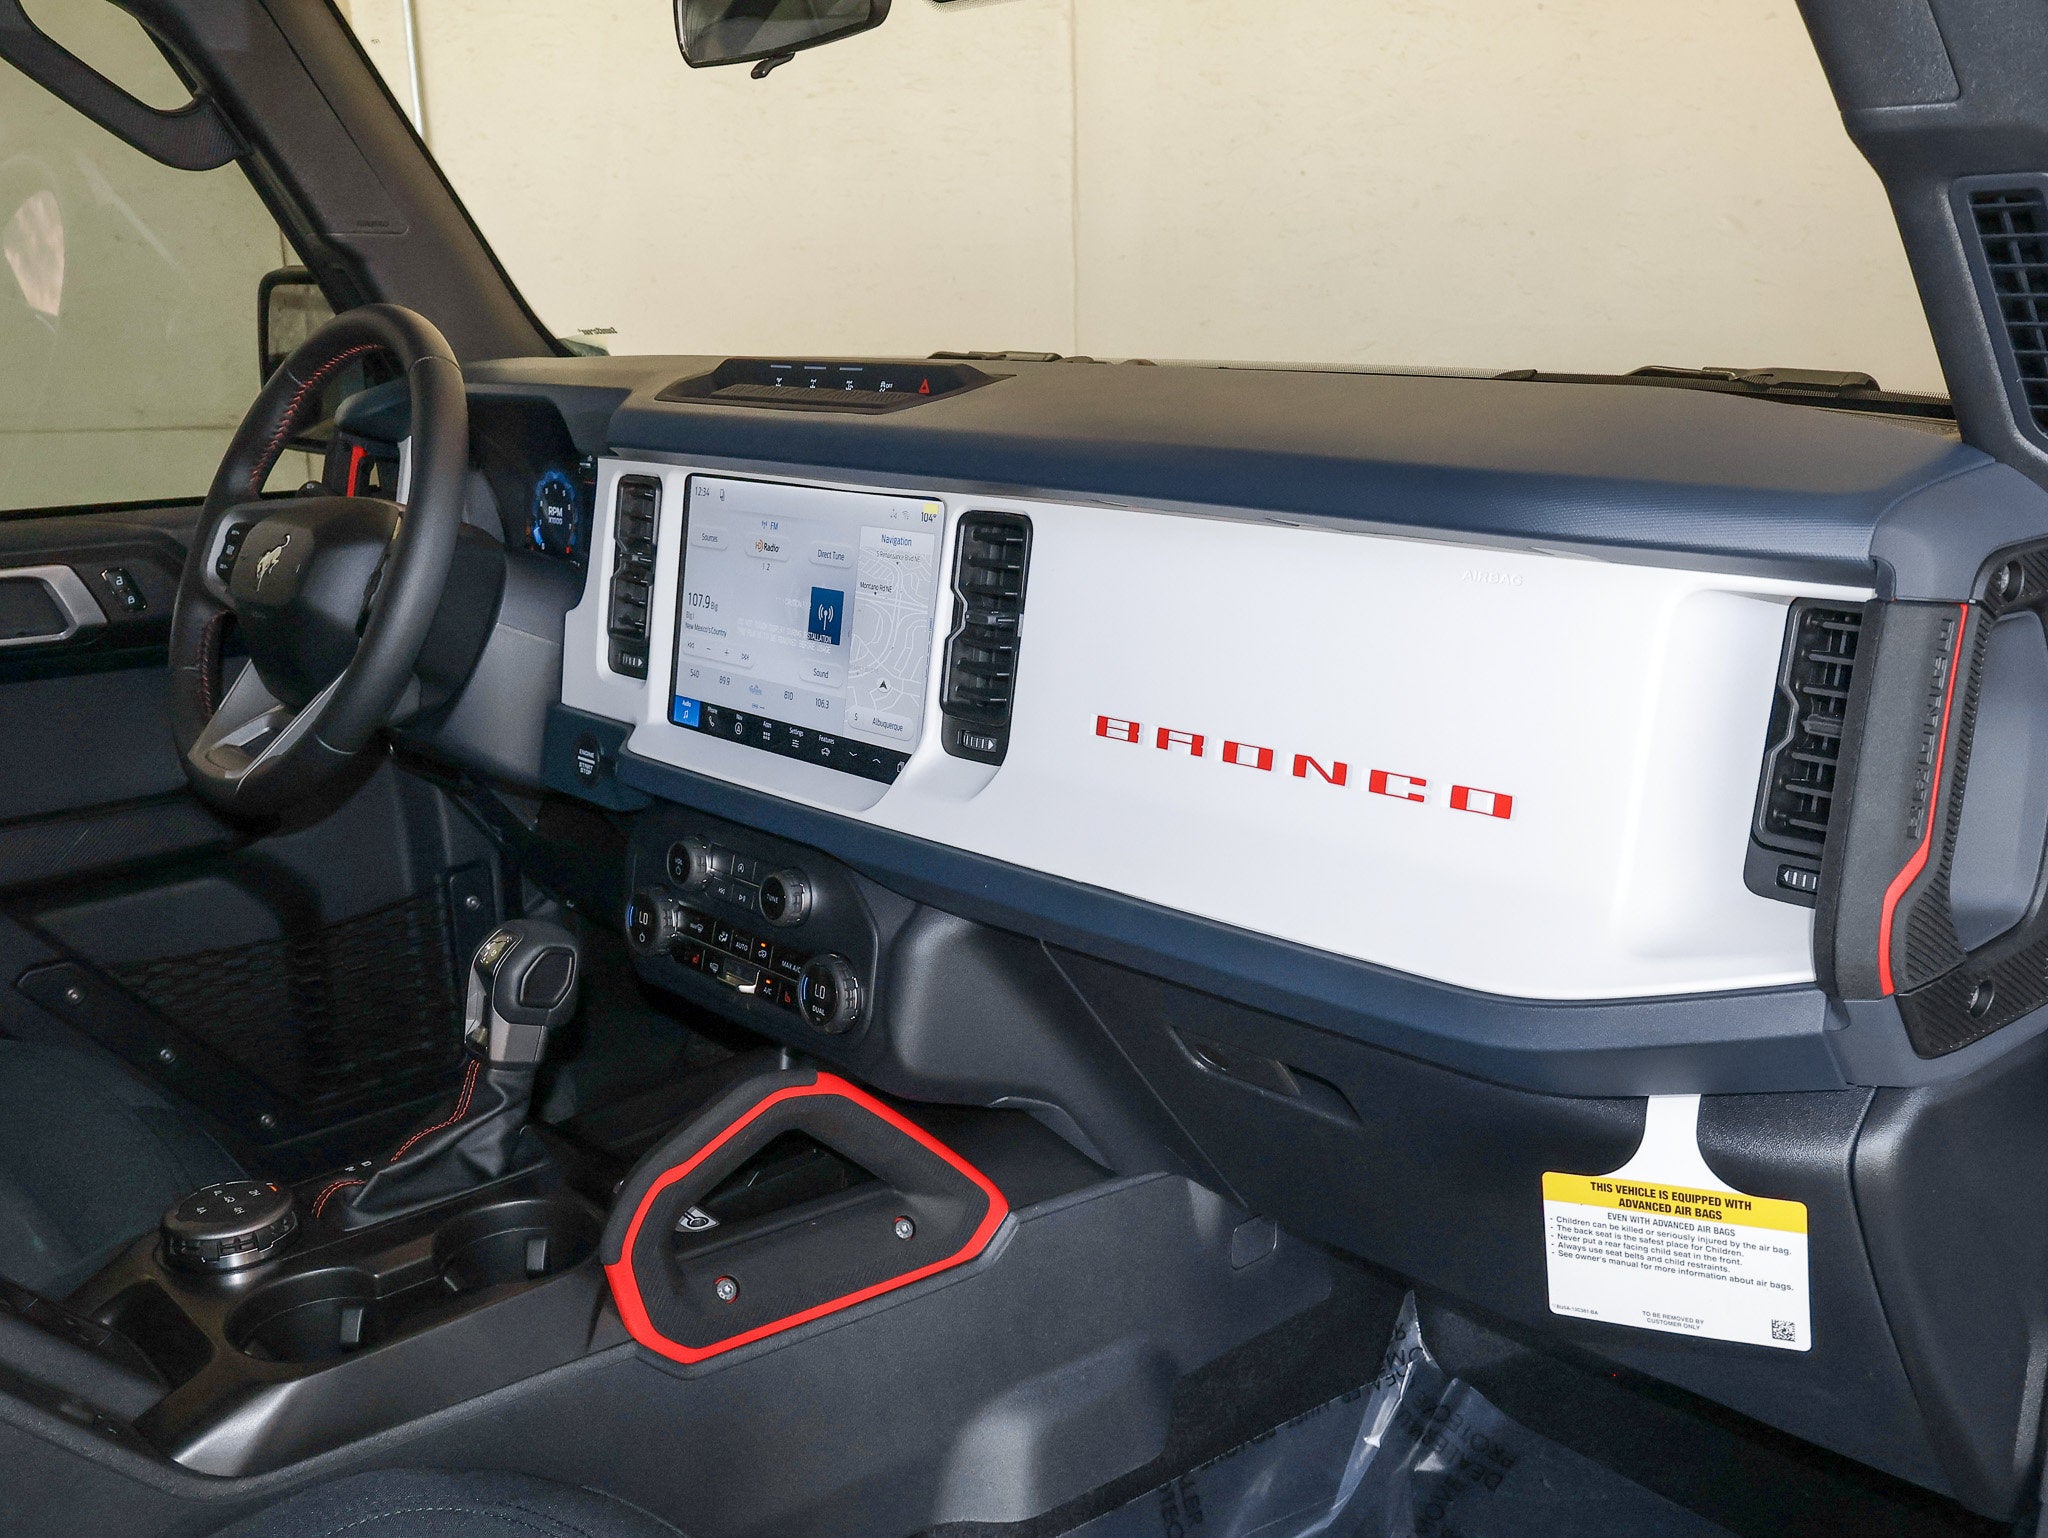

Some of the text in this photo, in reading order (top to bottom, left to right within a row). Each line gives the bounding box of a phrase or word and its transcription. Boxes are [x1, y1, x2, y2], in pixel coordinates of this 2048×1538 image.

[695, 486, 710, 497] 12:34
[548, 506, 563, 518] RPM
[920, 512, 937, 522] 104°
[770, 522, 778, 530] FM
[702, 532, 719, 543] Sources
[881, 534, 912, 546] Navigation
[817, 549, 845, 561] Direct Tune
[1462, 569, 1525, 587] AIRBAG
[688, 592, 718, 612] 107.9 Big
[685, 622, 694, 630] New
[690, 668, 700, 678] 540
[813, 668, 829, 679] Sound
[719, 676, 730, 686] 89.9
[815, 698, 830, 710] 106.3
[872, 717, 903, 732] Albuquerque
[789, 726, 804, 738] Settings
[818, 734, 835, 745] Features
[1095, 714, 1513, 820] BRONCO
[766, 893, 779, 904] TUNE
[736, 941, 748, 951] AUTO
[782, 960, 792, 970] MAX
[814, 984, 826, 1000] LO
[812, 1004, 826, 1016] DUAL
[1590, 1182, 1752, 1210] THIS VEHICLE IS EQUIPPED WITH
[1618, 1198, 1722, 1220] ADVANCED AIR BAGS
[1607, 1212, 1736, 1237] EVEN WITH ADVANCED AIR BAGS
[1556, 1216, 1590, 1226] Children
[1609, 1223, 1620, 1231] be
[1622, 1224, 1644, 1234] killed
[1656, 1231, 1696, 1242] seriously
[1698, 1236, 1728, 1246] injured
[1730, 1240, 1740, 1249] by
[1742, 1242, 1757, 1250] the
[1758, 1244, 1770, 1252] air
[1772, 1246, 1792, 1256] bag.
[1557, 1224, 1572, 1233] The
[1574, 1226, 1593, 1236] back
[1595, 1230, 1612, 1239] seat
[1614, 1232, 1622, 1240] is
[1623, 1234, 1637, 1242] the
[1639, 1236, 1664, 1246] safest
[1666, 1240, 1689, 1250] place
[1705, 1245, 1744, 1258] Children.
[1557, 1233, 1580, 1243] Never
[1623, 1242, 1649, 1254] facing
[1650, 1248, 1671, 1256] child
[1673, 1250, 1691, 1258] seat
[1694, 1252, 1702, 1260] in
[1704, 1254, 1718, 1262] the
[1720, 1256, 1743, 1266] front.
[1558, 1242, 1587, 1252] Always
[1588, 1246, 1603, 1254] use
[1605, 1248, 1623, 1257] seat
[1624, 1251, 1645, 1260] belts
[1664, 1258, 1685, 1266] child
[1688, 1261, 1730, 1273] restraints.
[1558, 1250, 1574, 1258] See
[1575, 1253, 1606, 1264] owner's
[1608, 1258, 1638, 1268] manual
[1640, 1262, 1652, 1270] for
[1654, 1265, 1676, 1274] more
[1678, 1268, 1727, 1282] information
[1729, 1275, 1754, 1285] about
[1770, 1280, 1794, 1292] bags.
[1646, 1318, 1700, 1330] CUSTOMER ONLY
[1662, 1314, 1694, 1324] REMOVED
